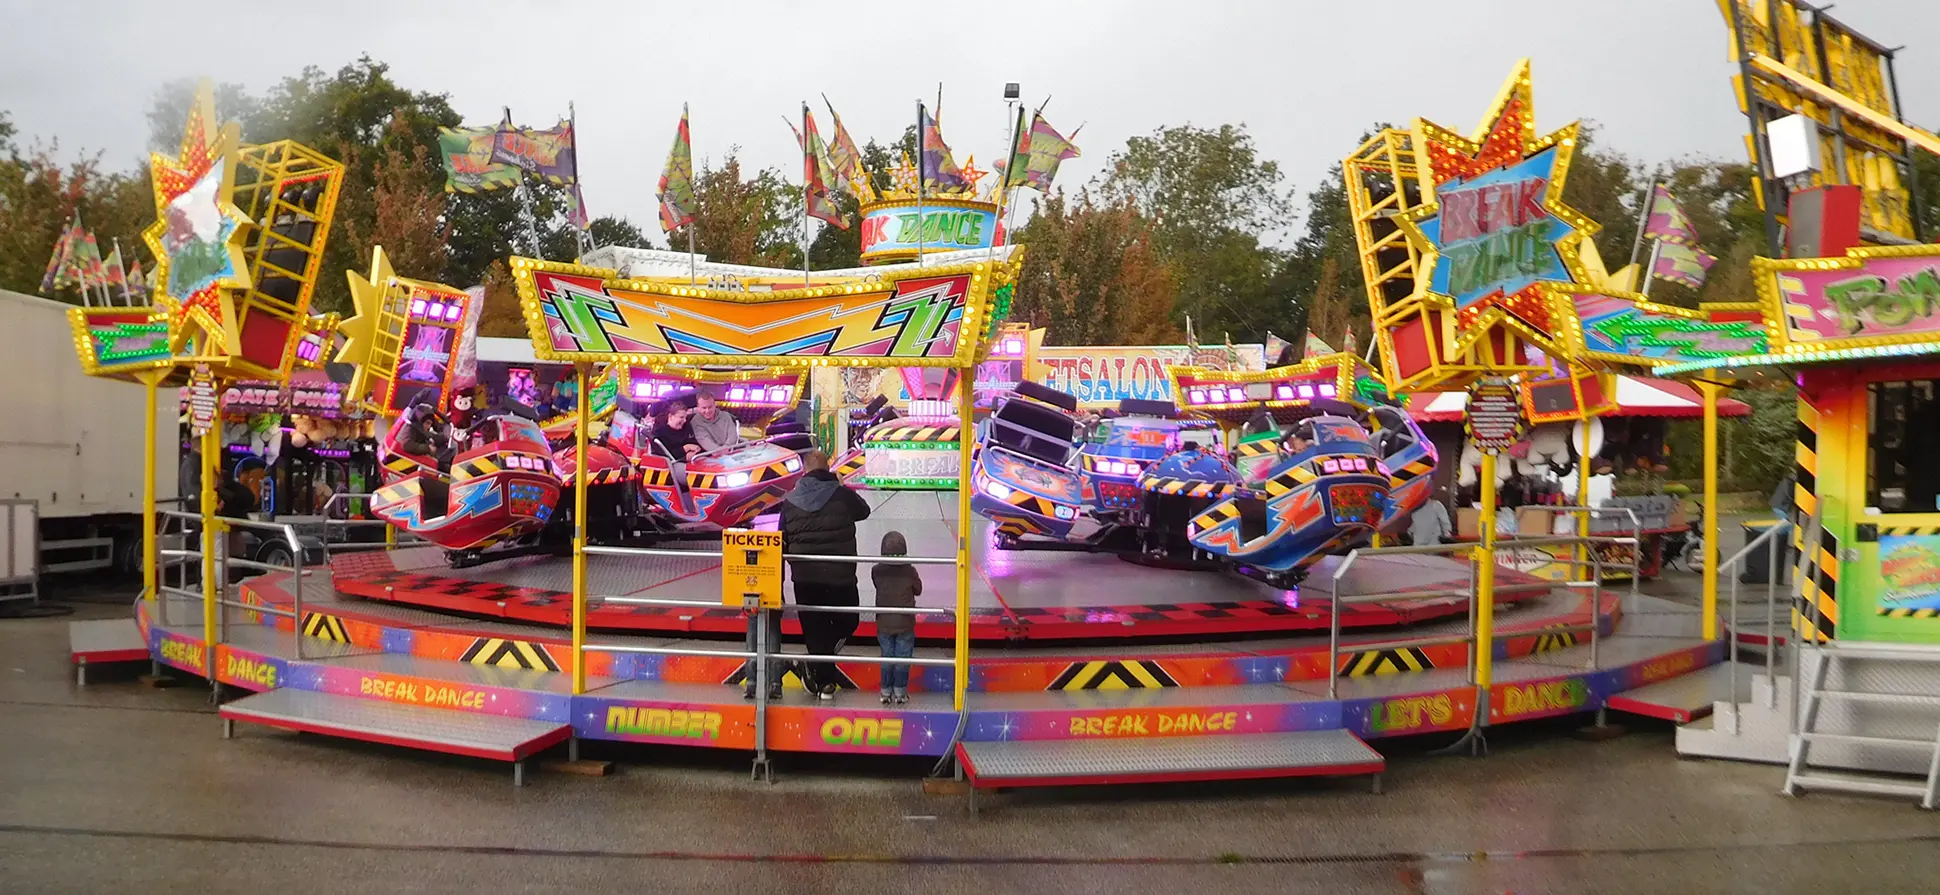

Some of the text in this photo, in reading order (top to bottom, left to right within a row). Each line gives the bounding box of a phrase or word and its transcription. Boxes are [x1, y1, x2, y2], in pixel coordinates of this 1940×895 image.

[895, 210, 985, 246] DANCE
[1439, 177, 1548, 245] BREAK
[724, 533, 781, 547] TICKETS
[160, 637, 277, 688] BREAK DANCE
[360, 676, 485, 709] BREAK DANCE
[1503, 677, 1587, 716] DANCE
[604, 705, 903, 747] NUMBER ONE
[1069, 711, 1238, 736] BREAK DANCE
